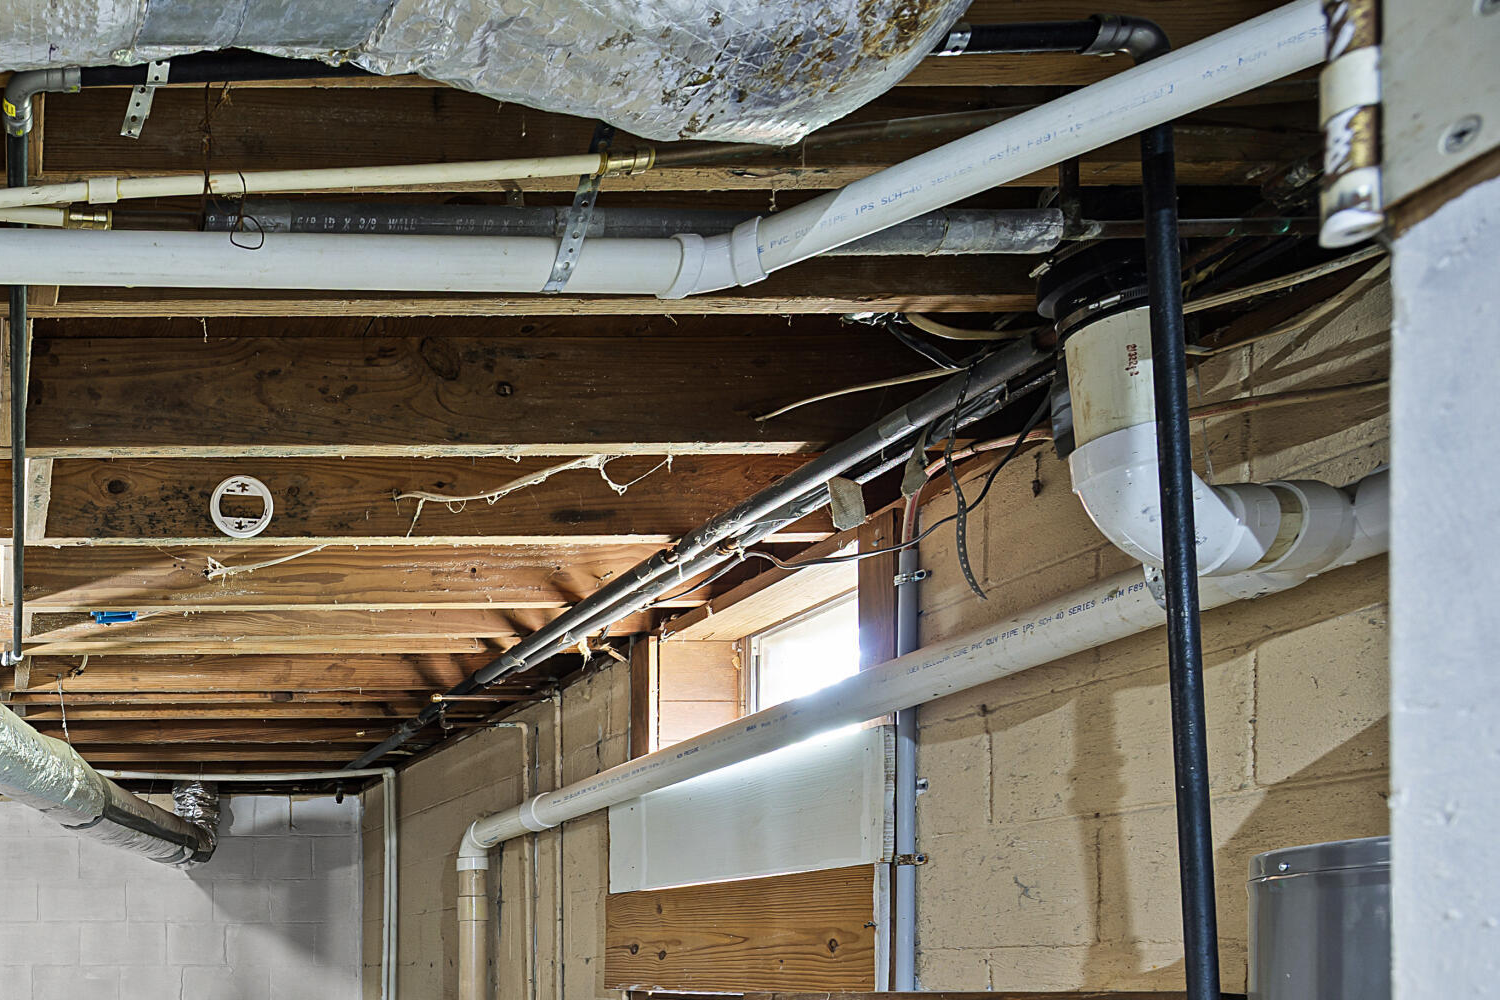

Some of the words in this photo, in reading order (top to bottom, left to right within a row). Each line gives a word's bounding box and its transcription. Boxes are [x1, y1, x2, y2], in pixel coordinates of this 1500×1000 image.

[1001, 627, 1019, 641] PIPE
[1022, 622, 1035, 634] IPS
[1068, 599, 1096, 616] SERIES
